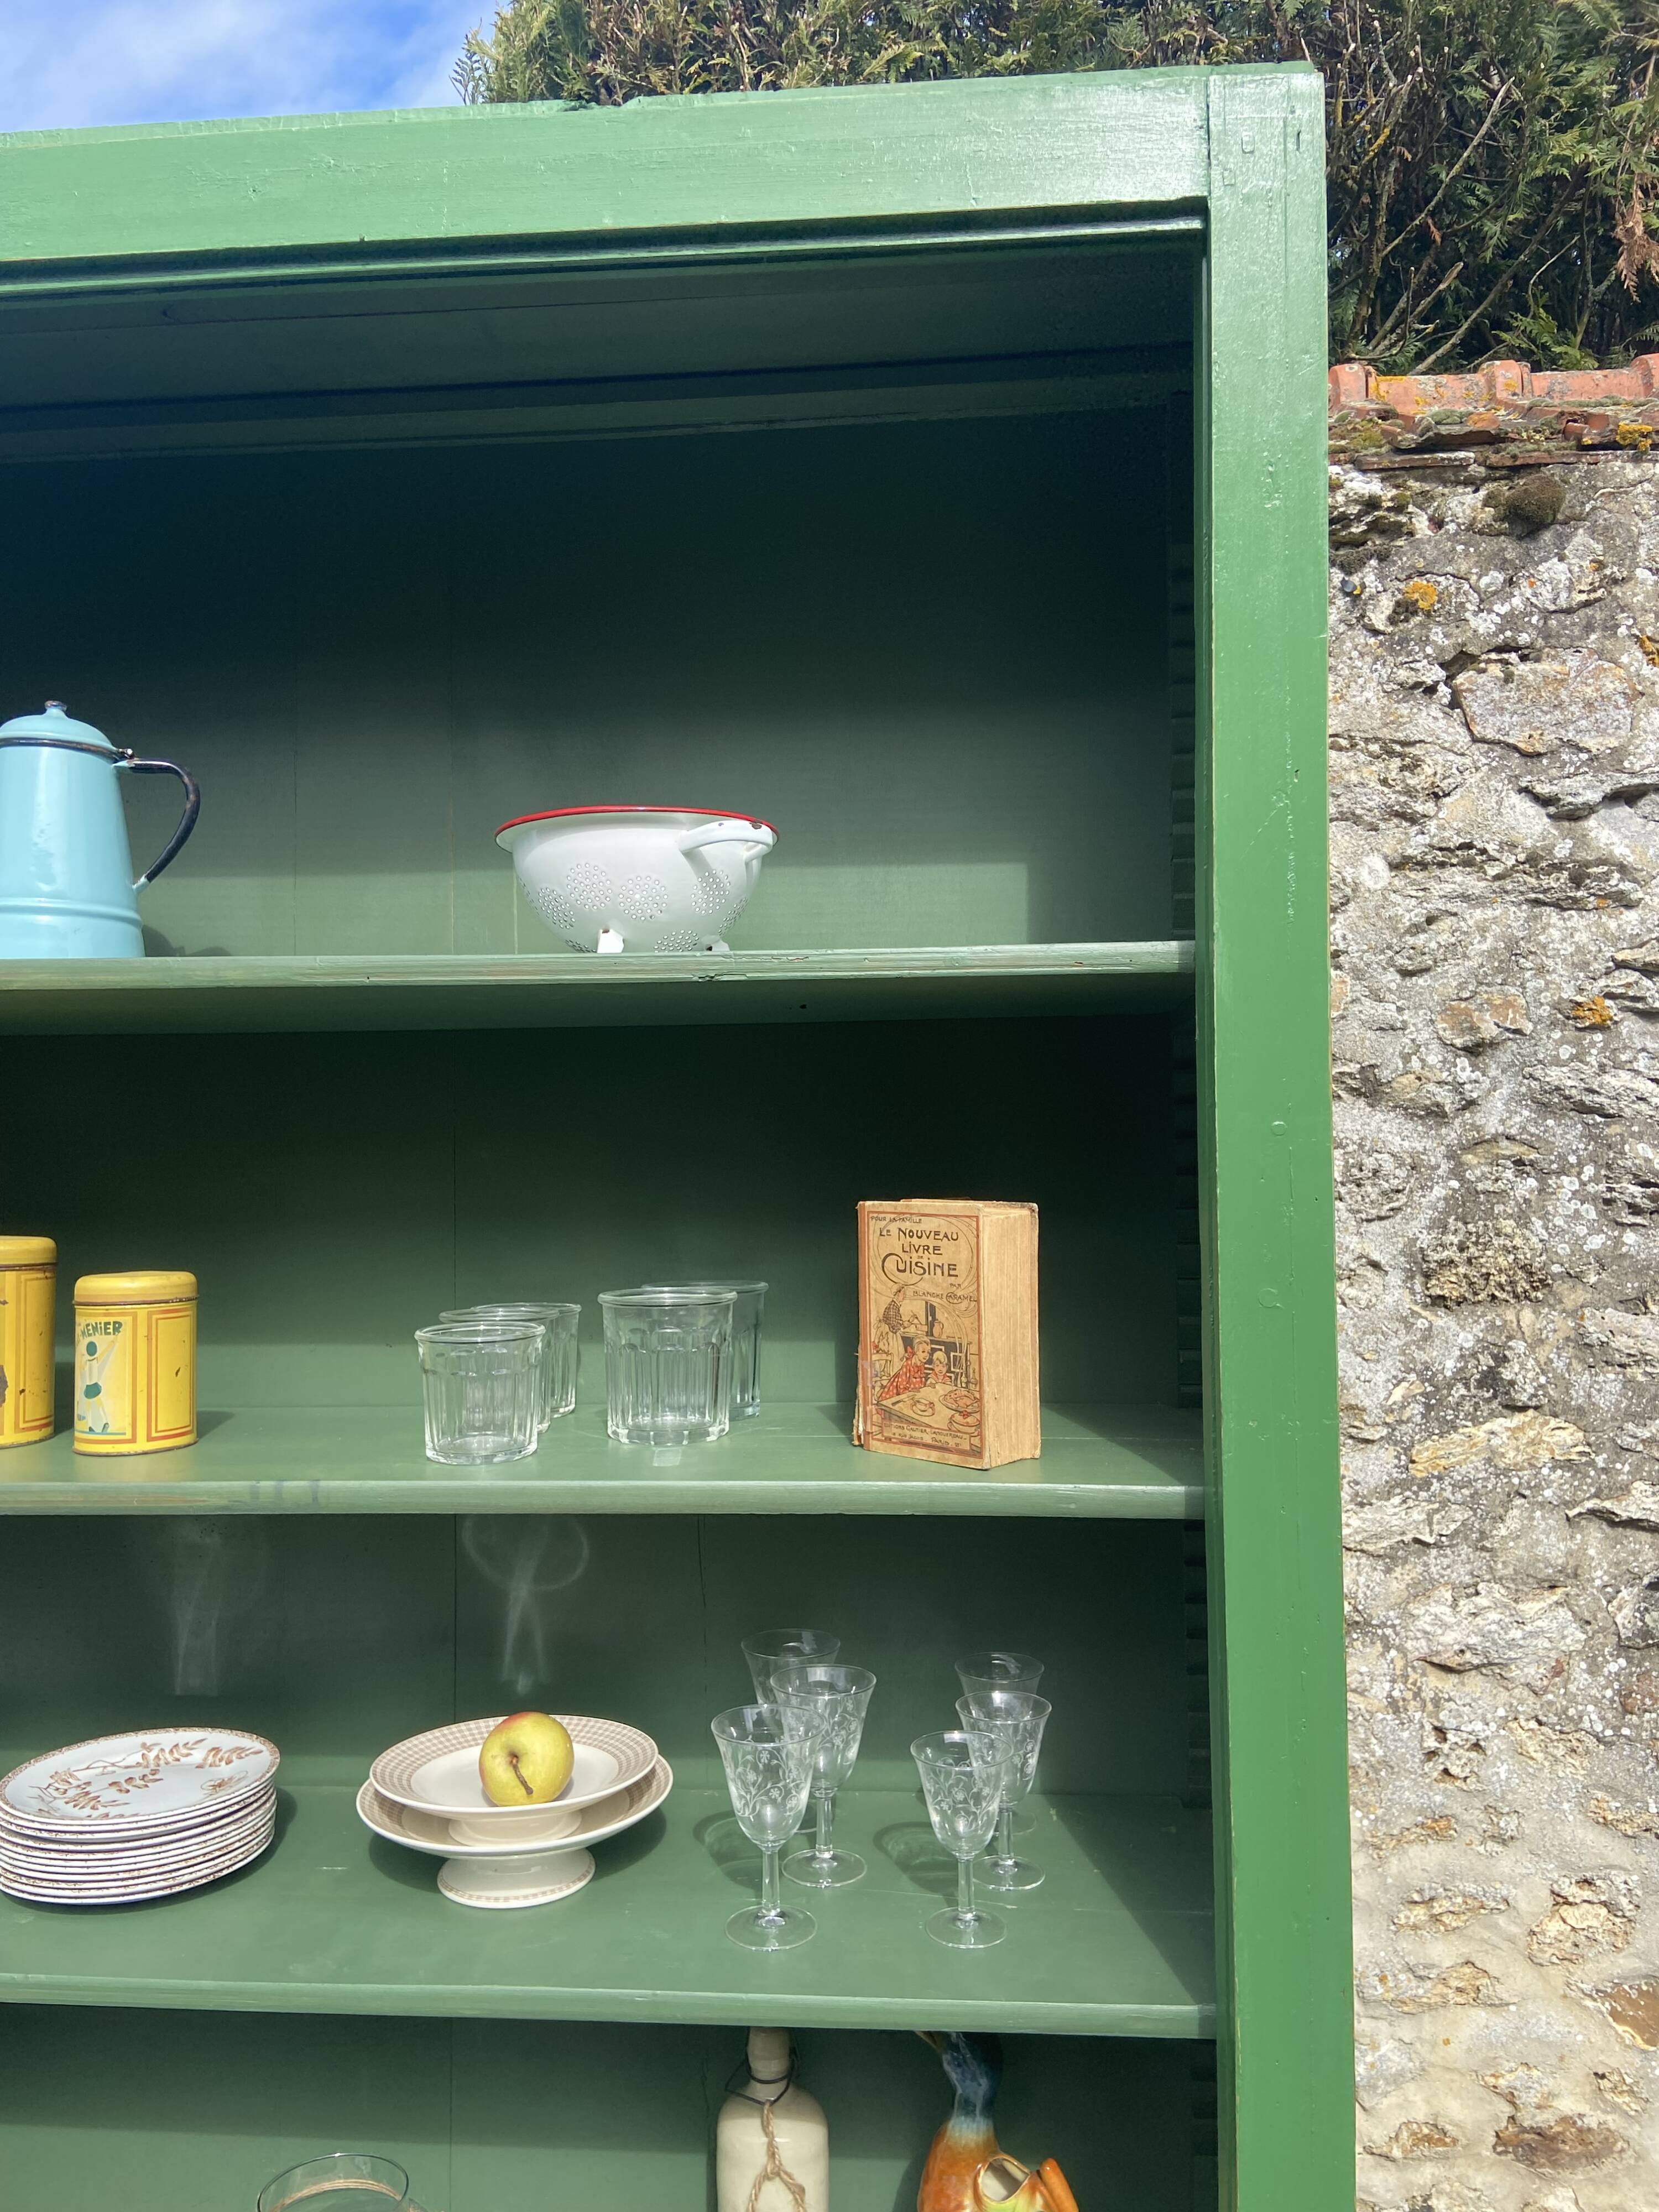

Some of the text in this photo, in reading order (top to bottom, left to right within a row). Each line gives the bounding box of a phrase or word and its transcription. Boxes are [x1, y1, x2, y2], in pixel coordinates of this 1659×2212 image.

[879, 1227, 959, 1242] LE NOUVEAU
[912, 1290, 978, 1305] BLANCHE CARAMEL
